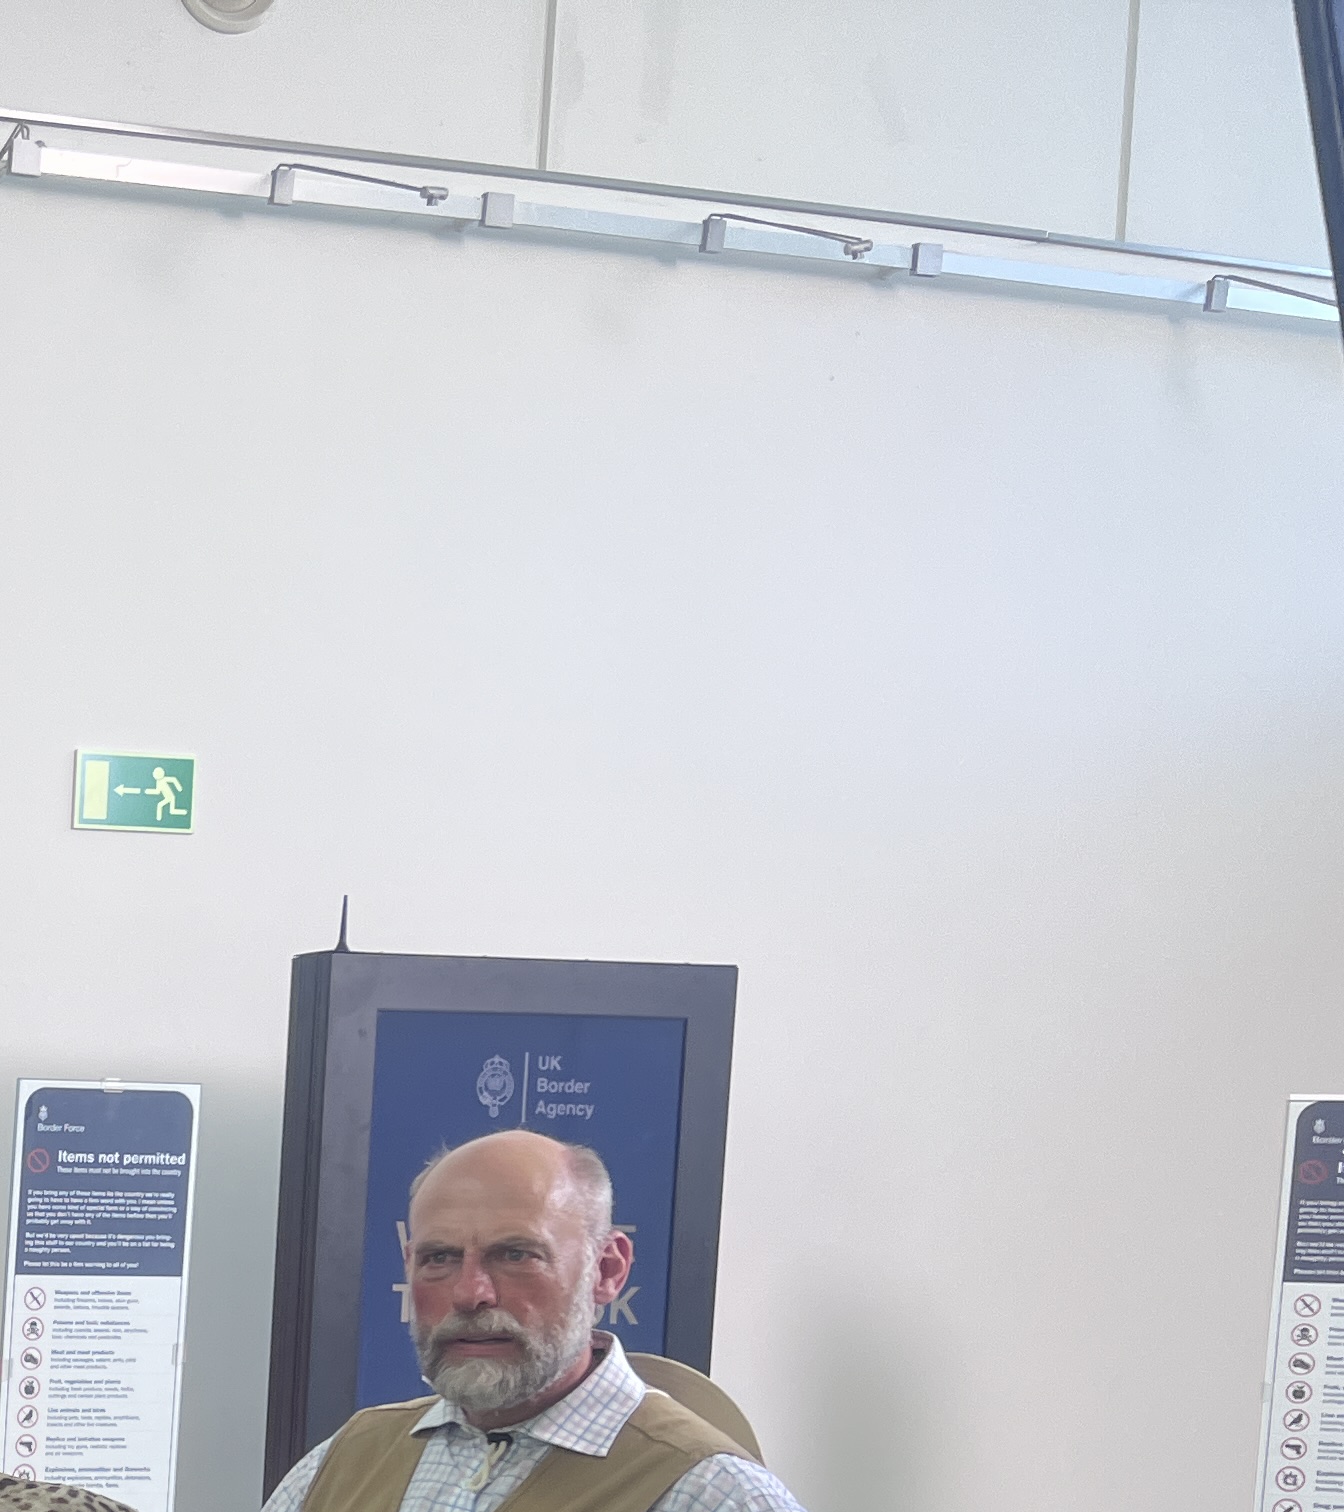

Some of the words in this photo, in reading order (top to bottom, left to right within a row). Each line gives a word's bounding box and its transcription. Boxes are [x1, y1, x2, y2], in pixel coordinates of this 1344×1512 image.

[537, 1056, 563, 1071] UK
[536, 1078, 591, 1094] Border
[534, 1101, 595, 1120] Agency
[37, 1123, 62, 1132] Border
[63, 1124, 85, 1132] Force
[58, 1150, 95, 1163] Items
[98, 1152, 120, 1163] not
[123, 1152, 186, 1165] permitted
